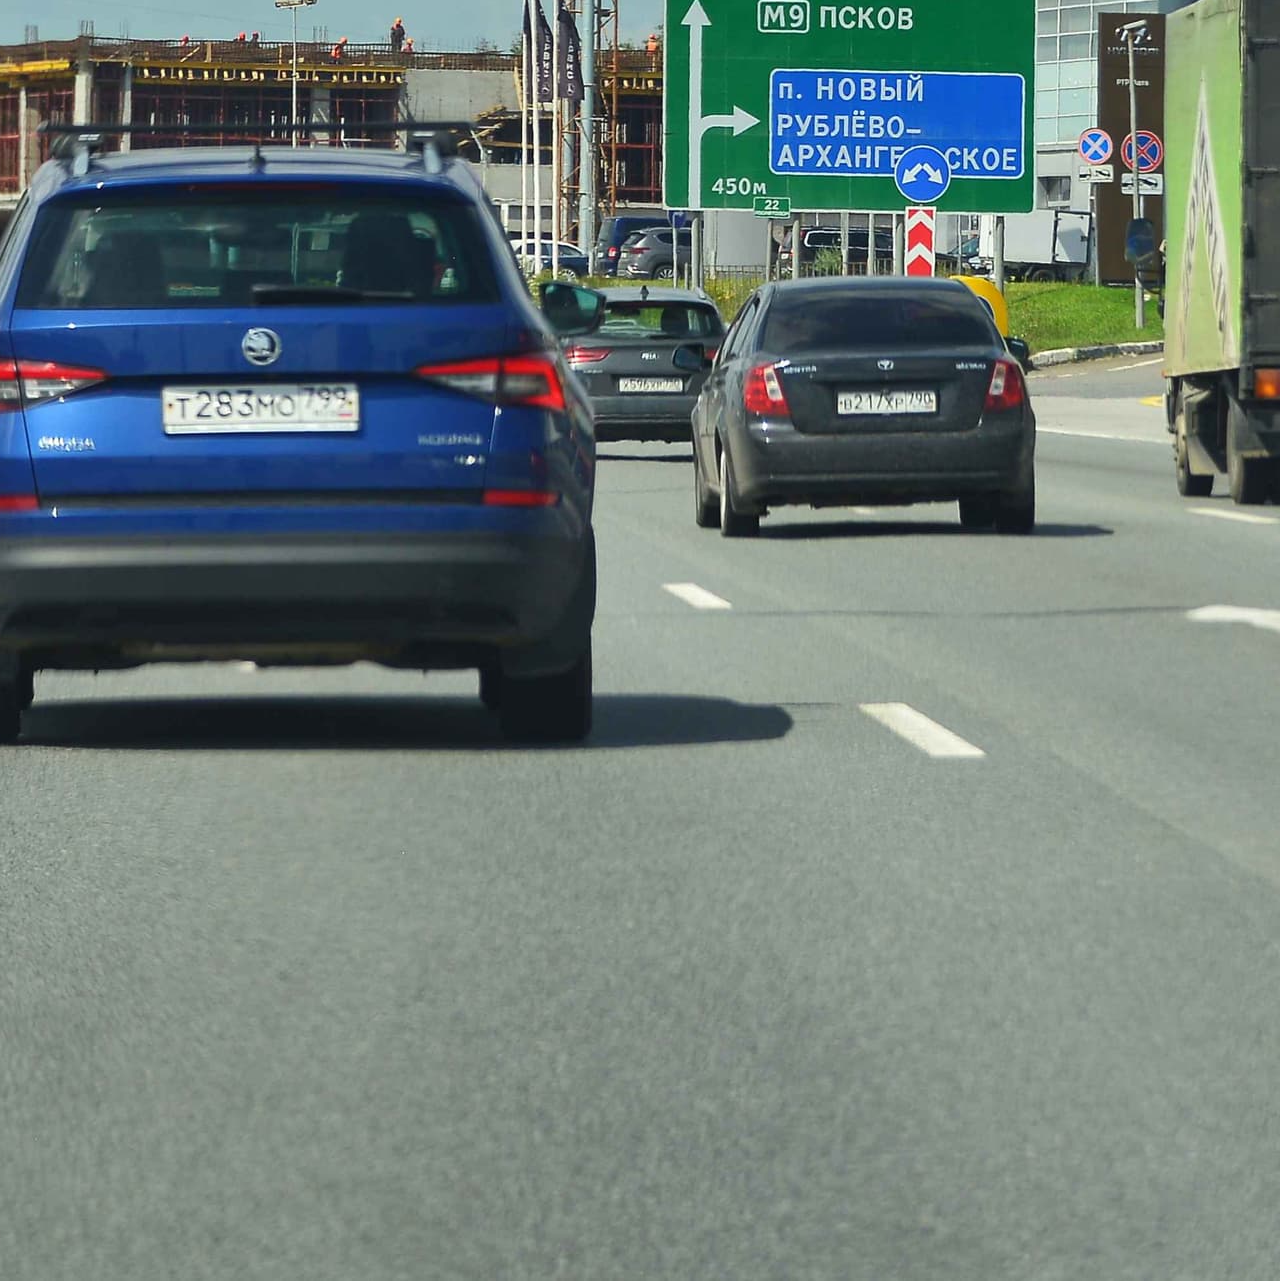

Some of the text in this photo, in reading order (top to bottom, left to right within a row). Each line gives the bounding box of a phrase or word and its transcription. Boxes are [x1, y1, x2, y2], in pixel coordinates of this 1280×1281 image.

[820, 6, 914, 30] ПСКОВ
[779, 74, 924, 102] п. НОВЫЙ
[777, 144, 1017, 172] АРХАНГЕСКОЕ
[764, 199, 780, 211] 22
